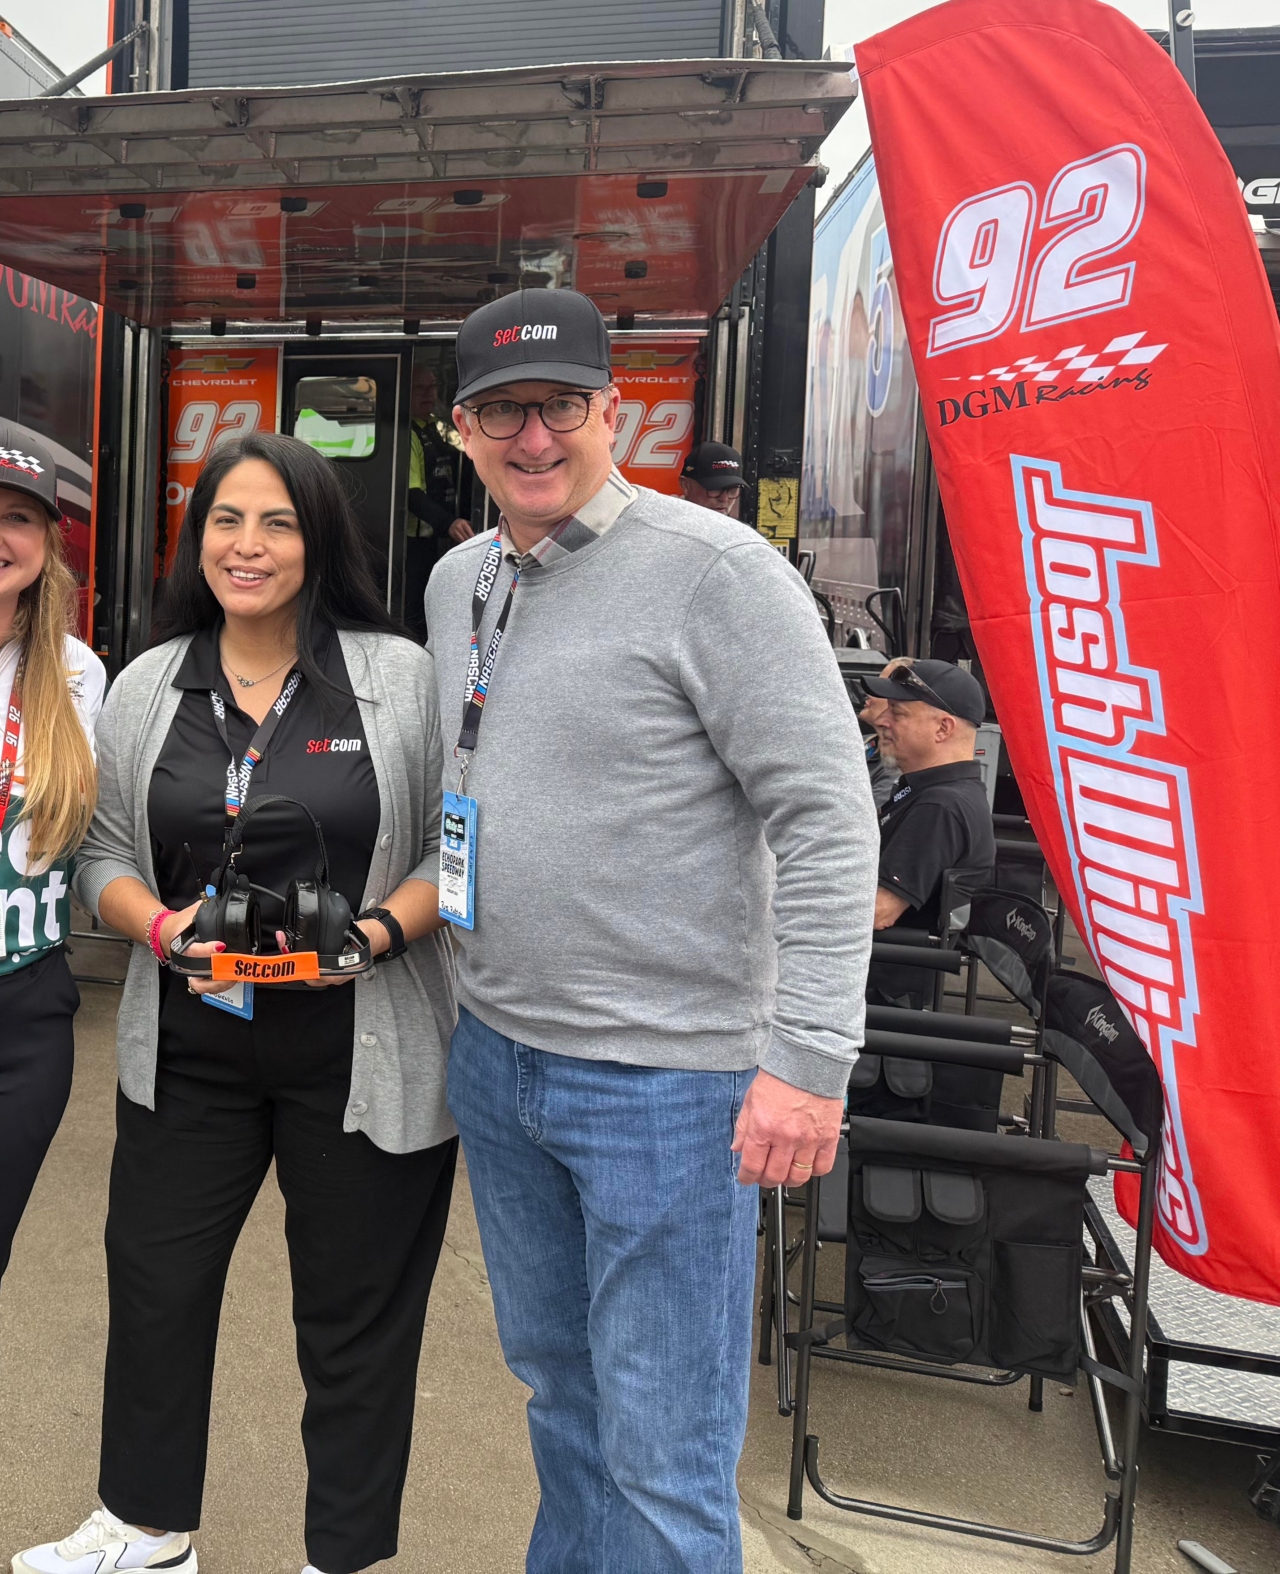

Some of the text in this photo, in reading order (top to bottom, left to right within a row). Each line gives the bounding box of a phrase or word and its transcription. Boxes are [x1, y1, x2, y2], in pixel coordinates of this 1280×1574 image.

[927, 143, 1145, 358] 92
[493, 324, 557, 347] setcom
[173, 379, 258, 387] CHEVROLET
[937, 367, 1153, 428] DGM Racing
[609, 400, 695, 468] 92
[0, 459, 39, 480] Racing
[475, 545, 501, 601] NASCAR
[1024, 464, 1154, 746] Josh
[479, 628, 503, 689] NASCAR
[9, 705, 21, 724] 92
[6, 731, 18, 747] 91
[307, 738, 362, 754] setcom
